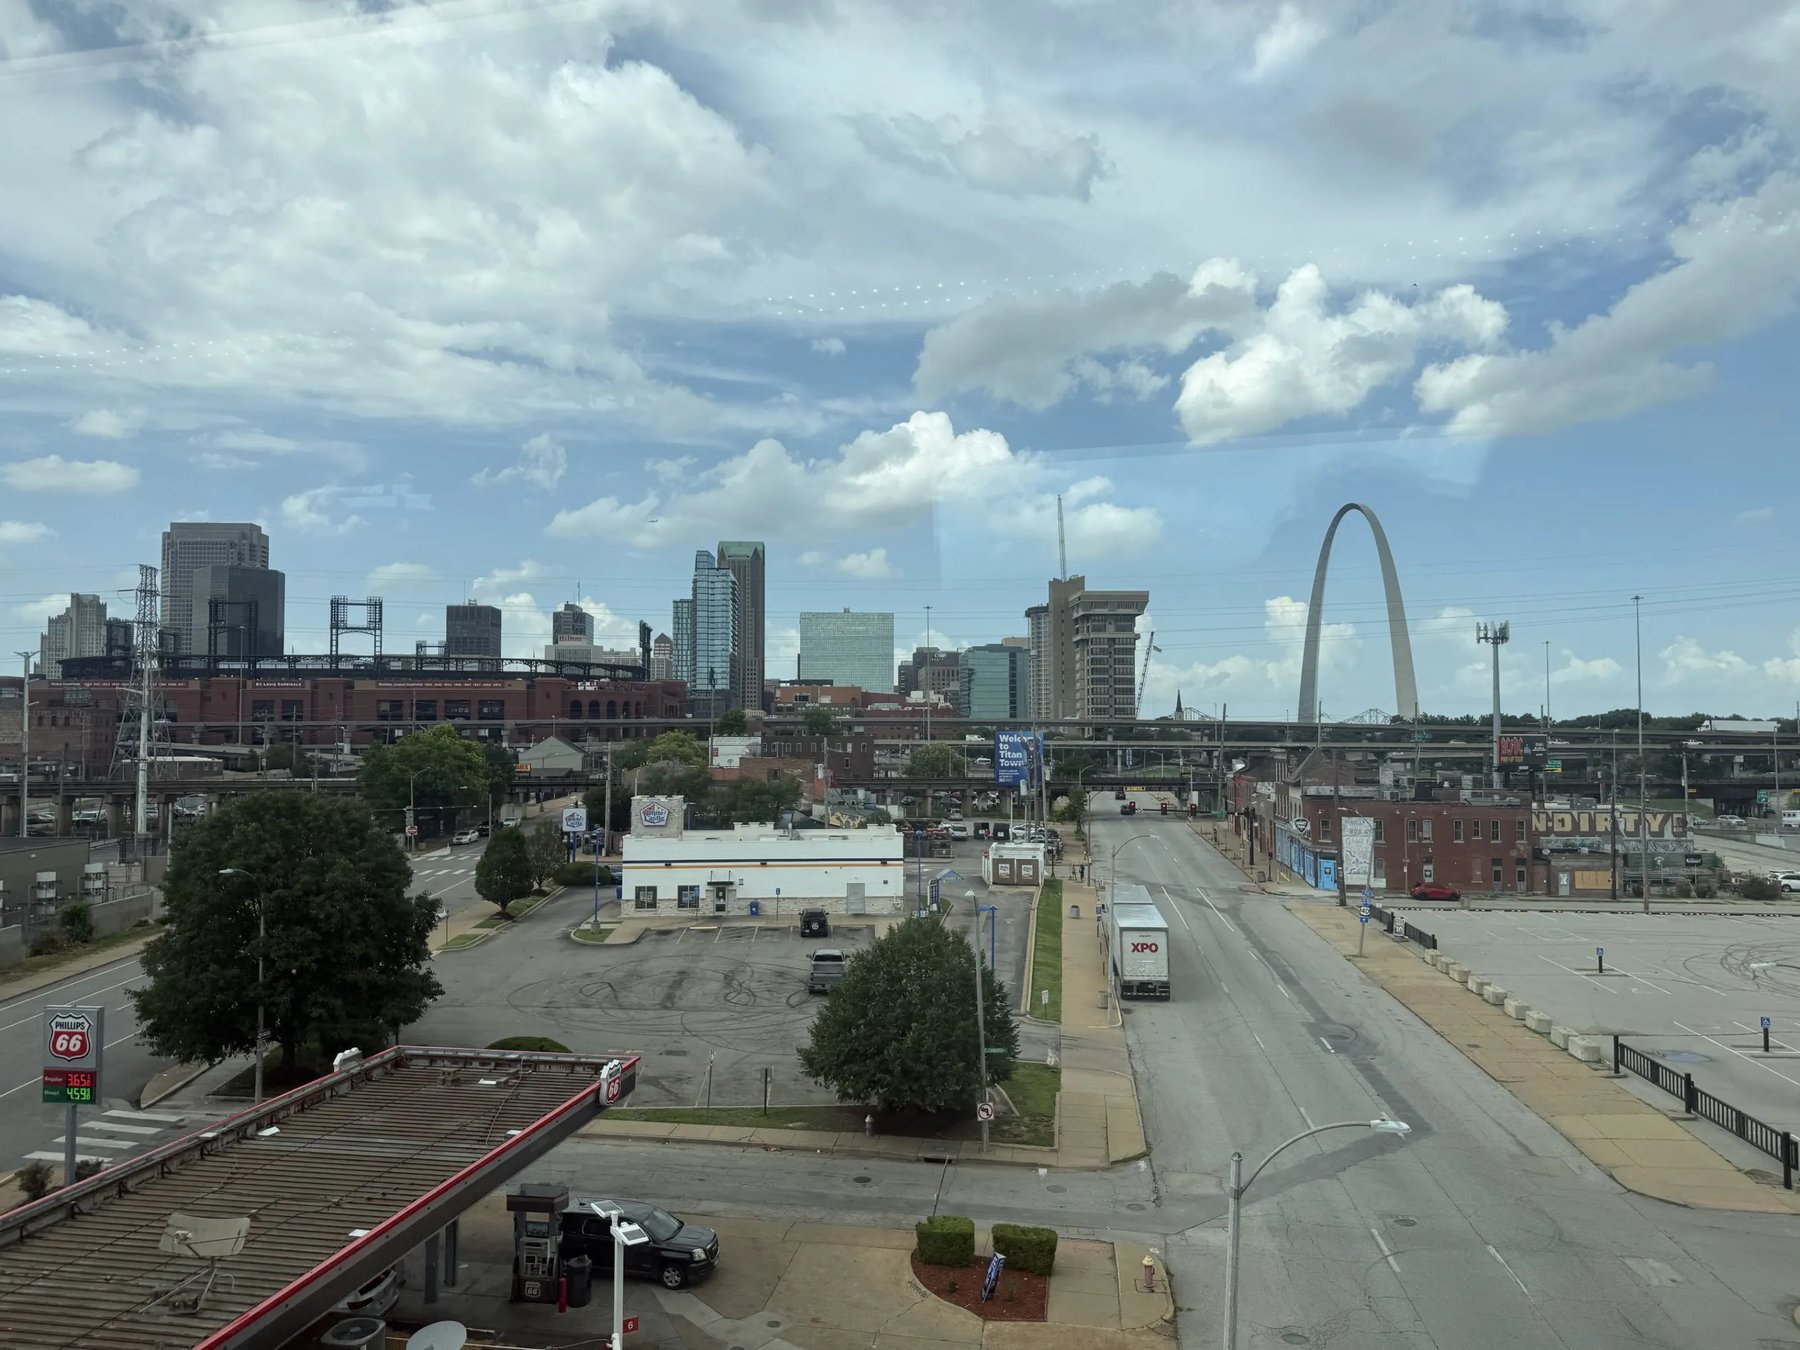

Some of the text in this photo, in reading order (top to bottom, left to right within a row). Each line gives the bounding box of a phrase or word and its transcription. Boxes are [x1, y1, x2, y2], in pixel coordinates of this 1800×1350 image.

[999, 750, 1023, 758] Titan
[1131, 943, 1159, 953] XPO
[55, 1021, 85, 1031] PHILLIPS
[56, 1034, 83, 1052] 66
[608, 1079, 619, 1098] 66
[527, 1287, 538, 1295] 66
[628, 1321, 634, 1330] 6
